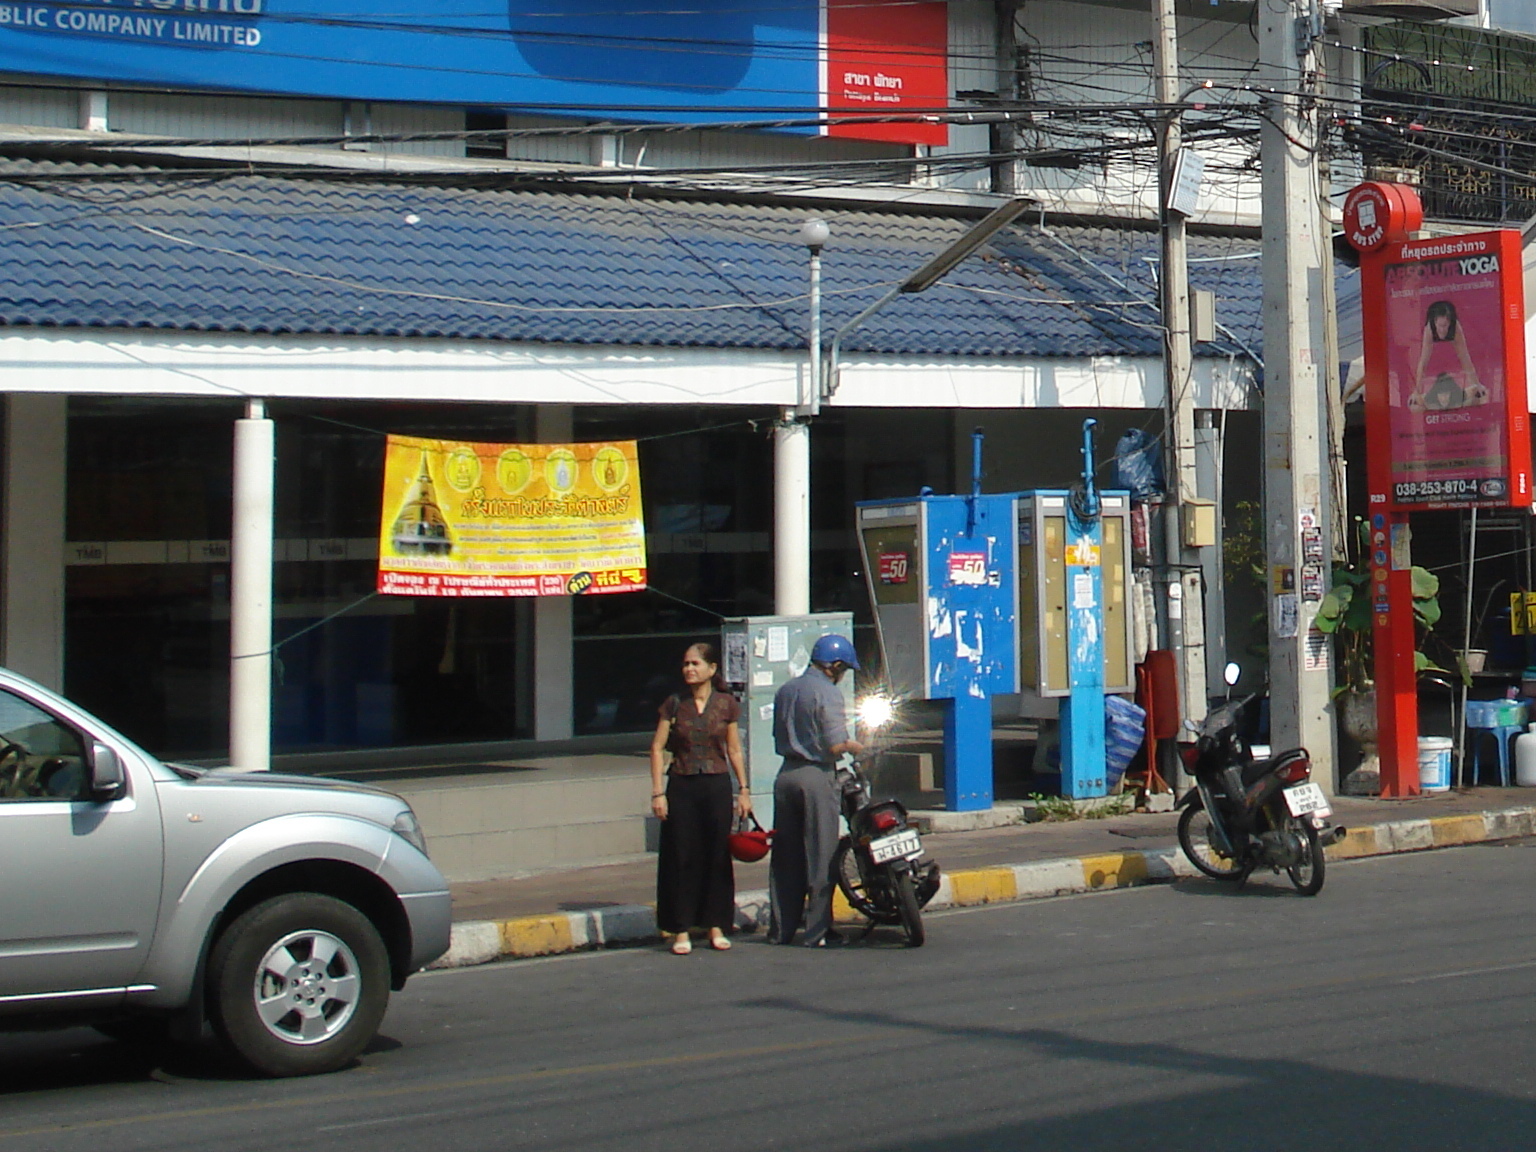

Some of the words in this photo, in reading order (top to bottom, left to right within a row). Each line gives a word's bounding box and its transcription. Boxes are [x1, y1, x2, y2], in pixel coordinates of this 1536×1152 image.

[55, 10, 167, 38] COMPANY
[174, 20, 262, 46] LIMITED
[1353, 231, 1367, 246] BUS
[1368, 226, 1383, 246] STOP
[1459, 255, 1500, 276] YOGA
[1425, 414, 1440, 425] GET
[1396, 479, 1478, 497] 038-253-870-4
[1370, 494, 1386, 503] R29
[890, 560, 907, 578] 50
